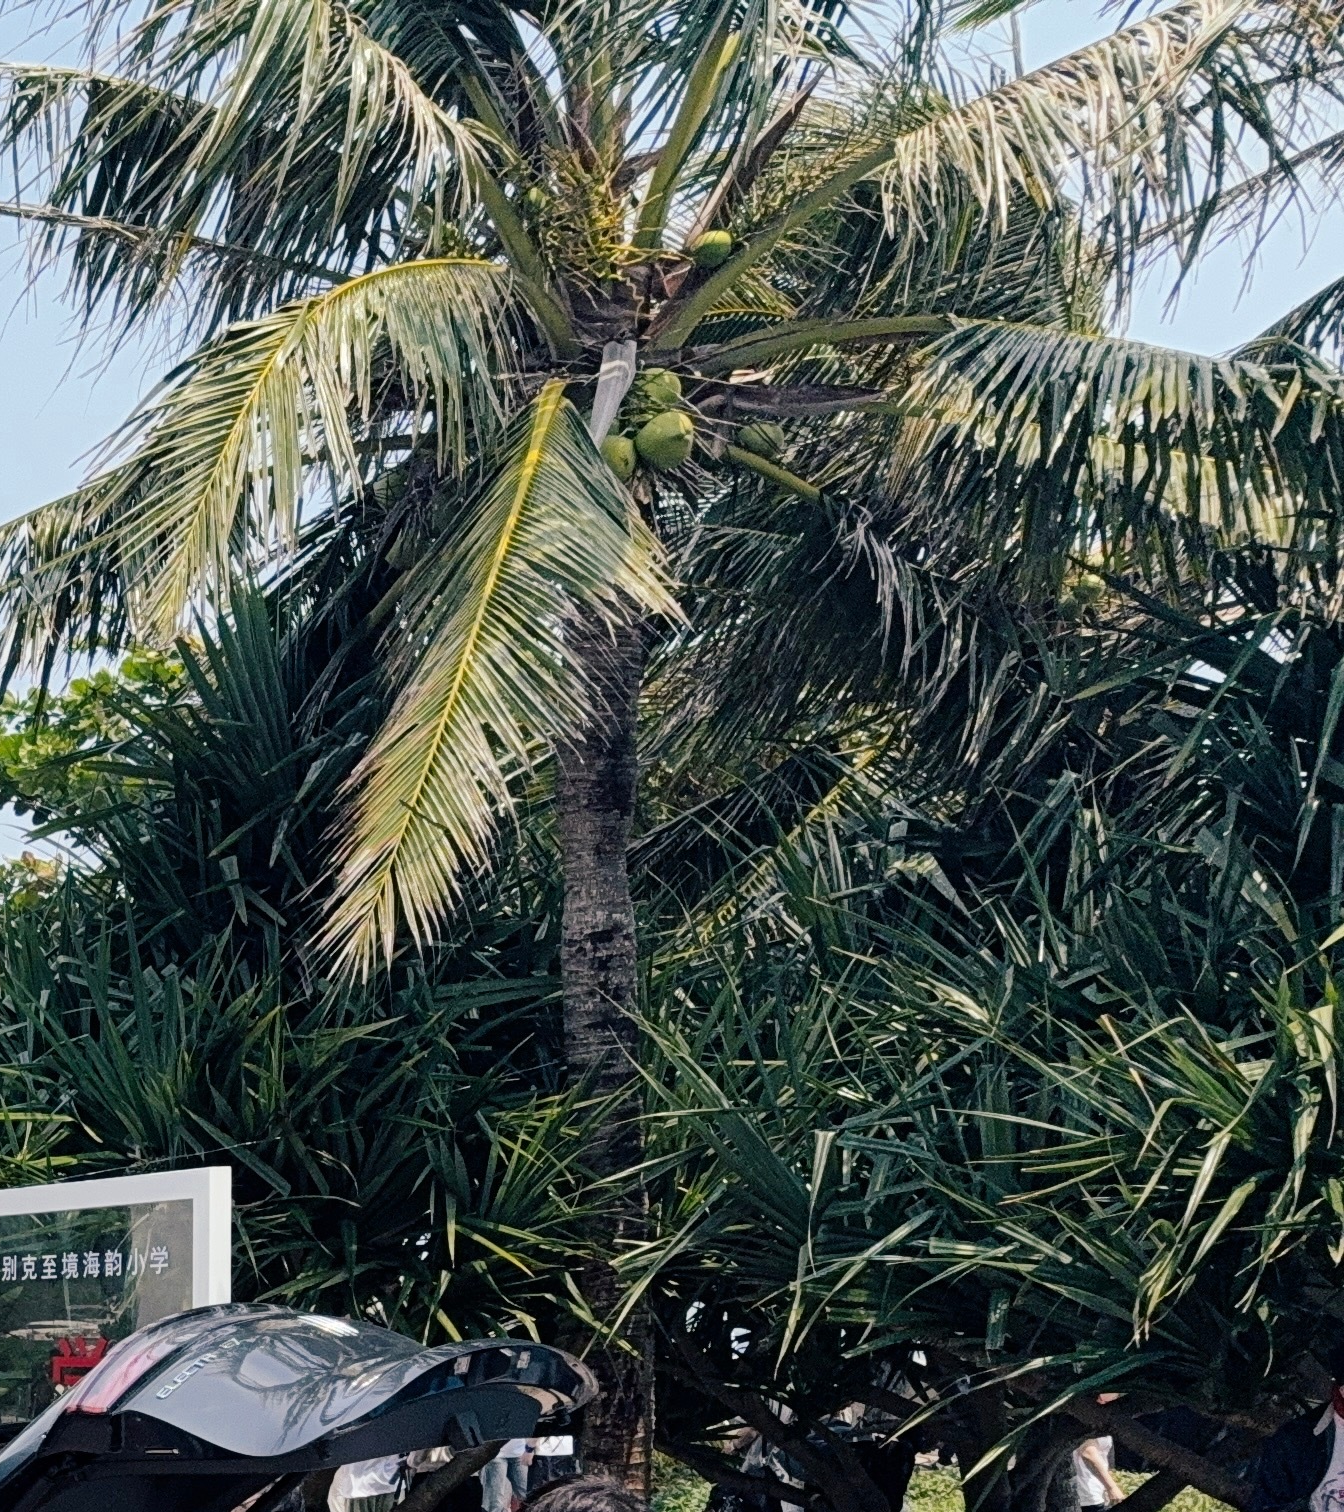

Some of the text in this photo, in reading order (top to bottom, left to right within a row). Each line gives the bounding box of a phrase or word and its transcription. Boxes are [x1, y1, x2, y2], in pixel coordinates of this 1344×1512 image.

[0, 1246, 169, 1282] 别克至境海韵小学
